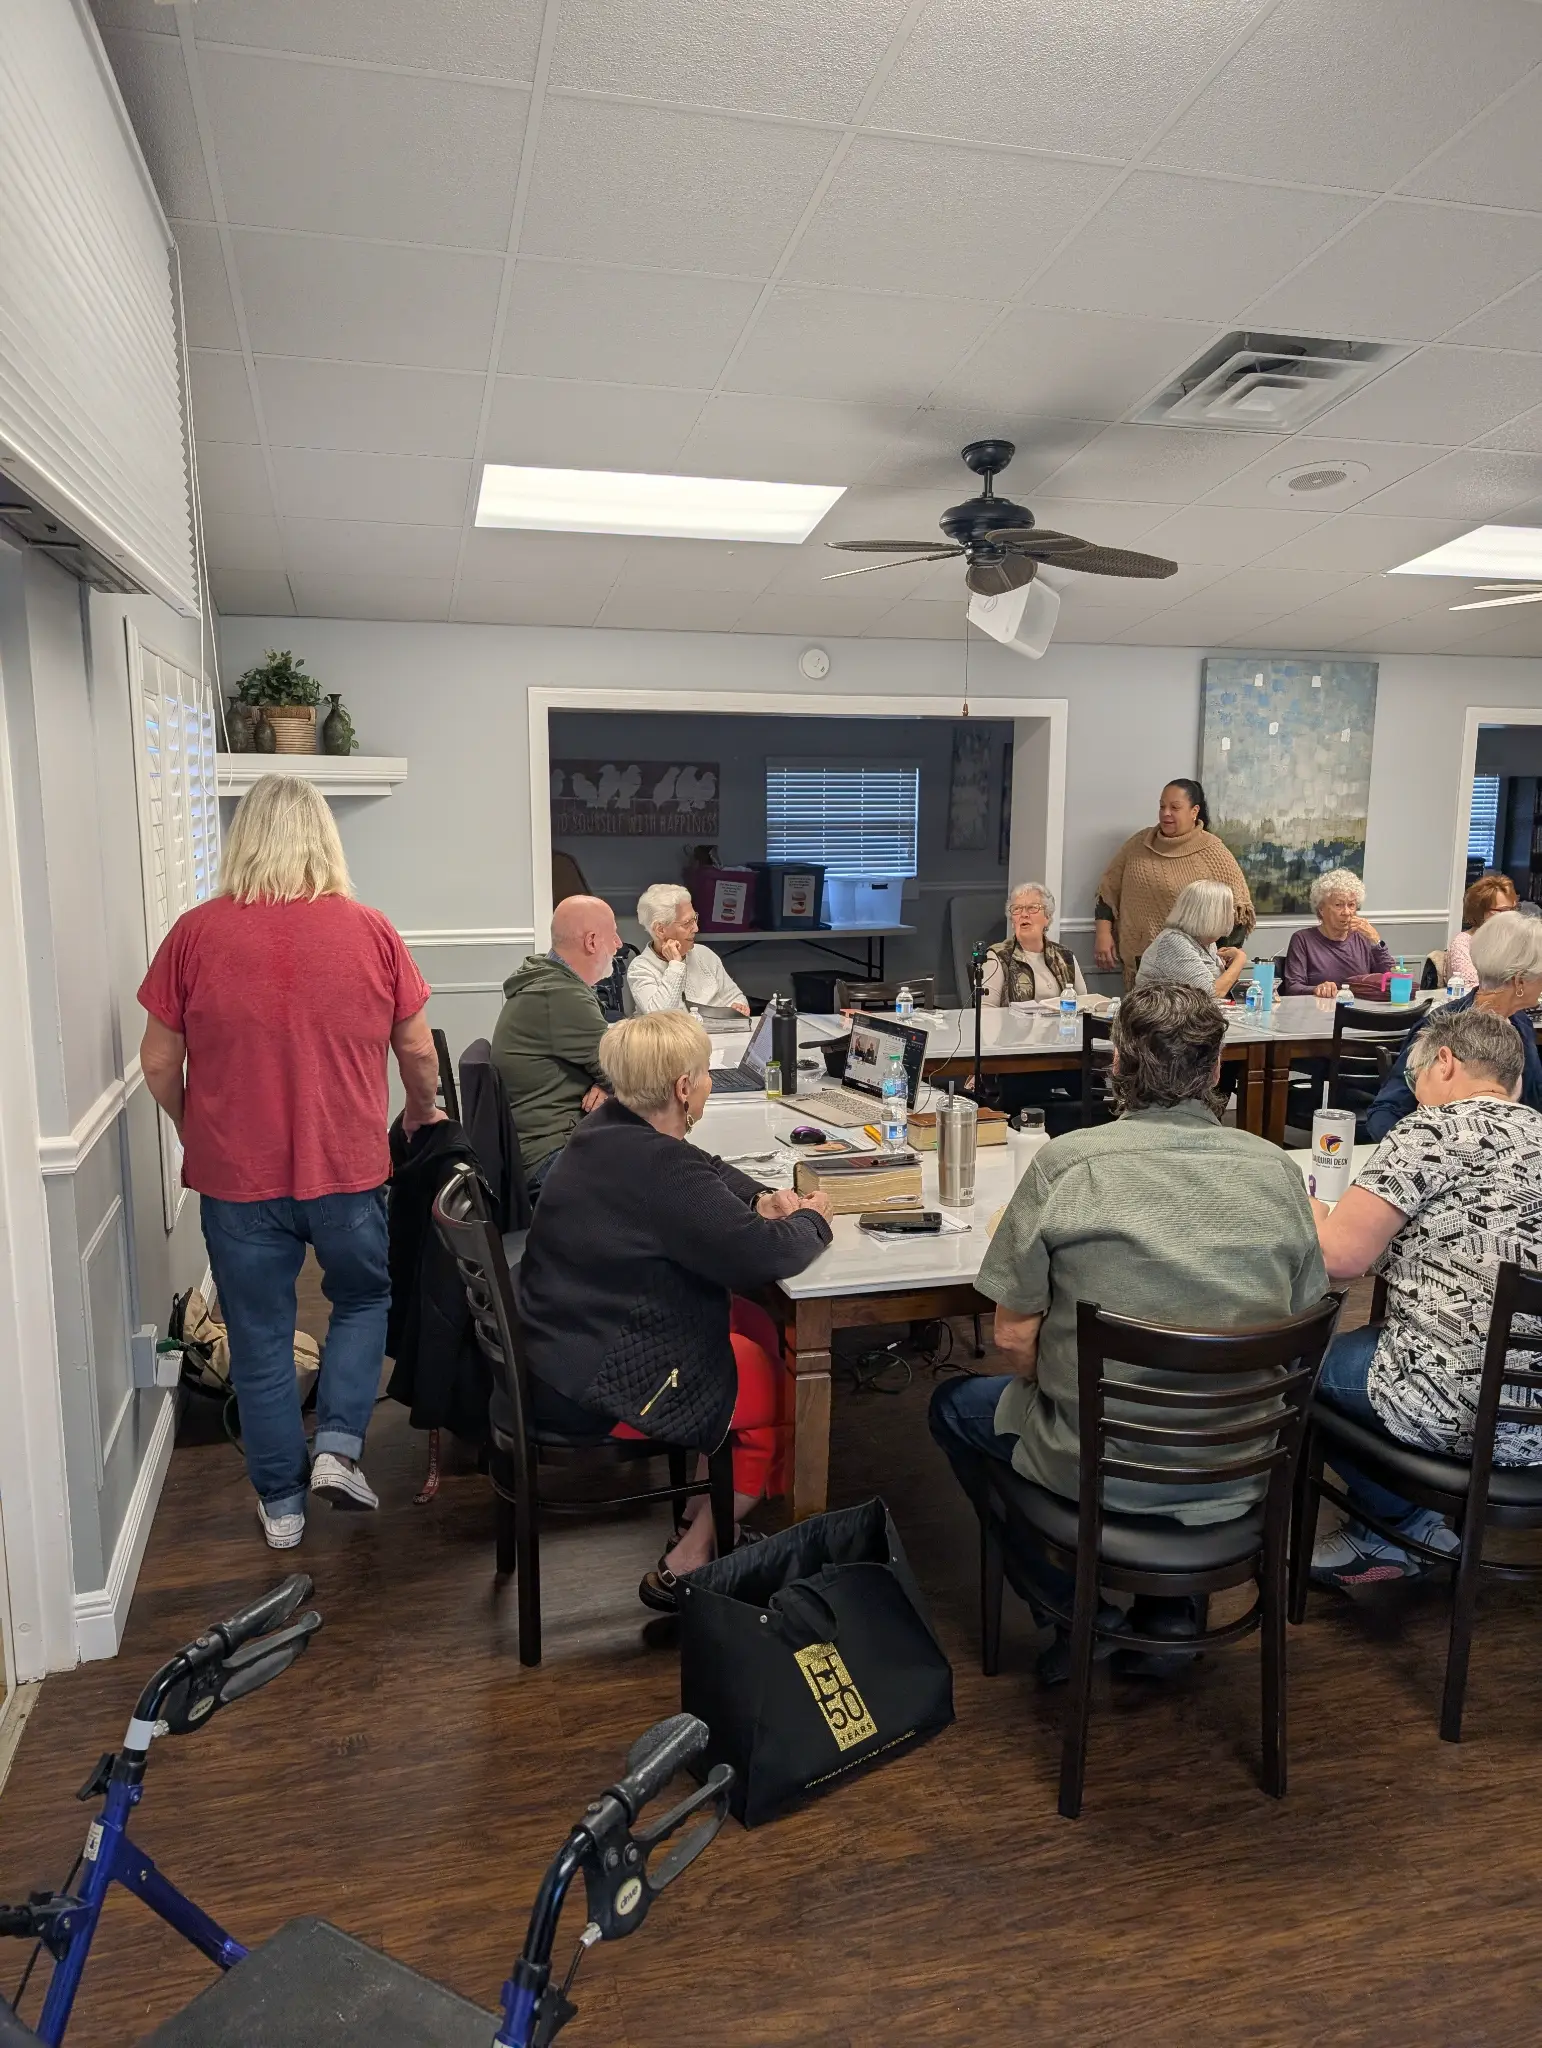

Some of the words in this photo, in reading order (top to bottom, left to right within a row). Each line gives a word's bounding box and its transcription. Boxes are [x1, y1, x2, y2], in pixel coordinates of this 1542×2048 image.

[573, 813, 624, 832] YOURSELF
[628, 813, 656, 832] WITH
[660, 812, 718, 834] HAPPINESS
[817, 1686, 865, 1731] 50
[839, 1722, 874, 1744] YEARS
